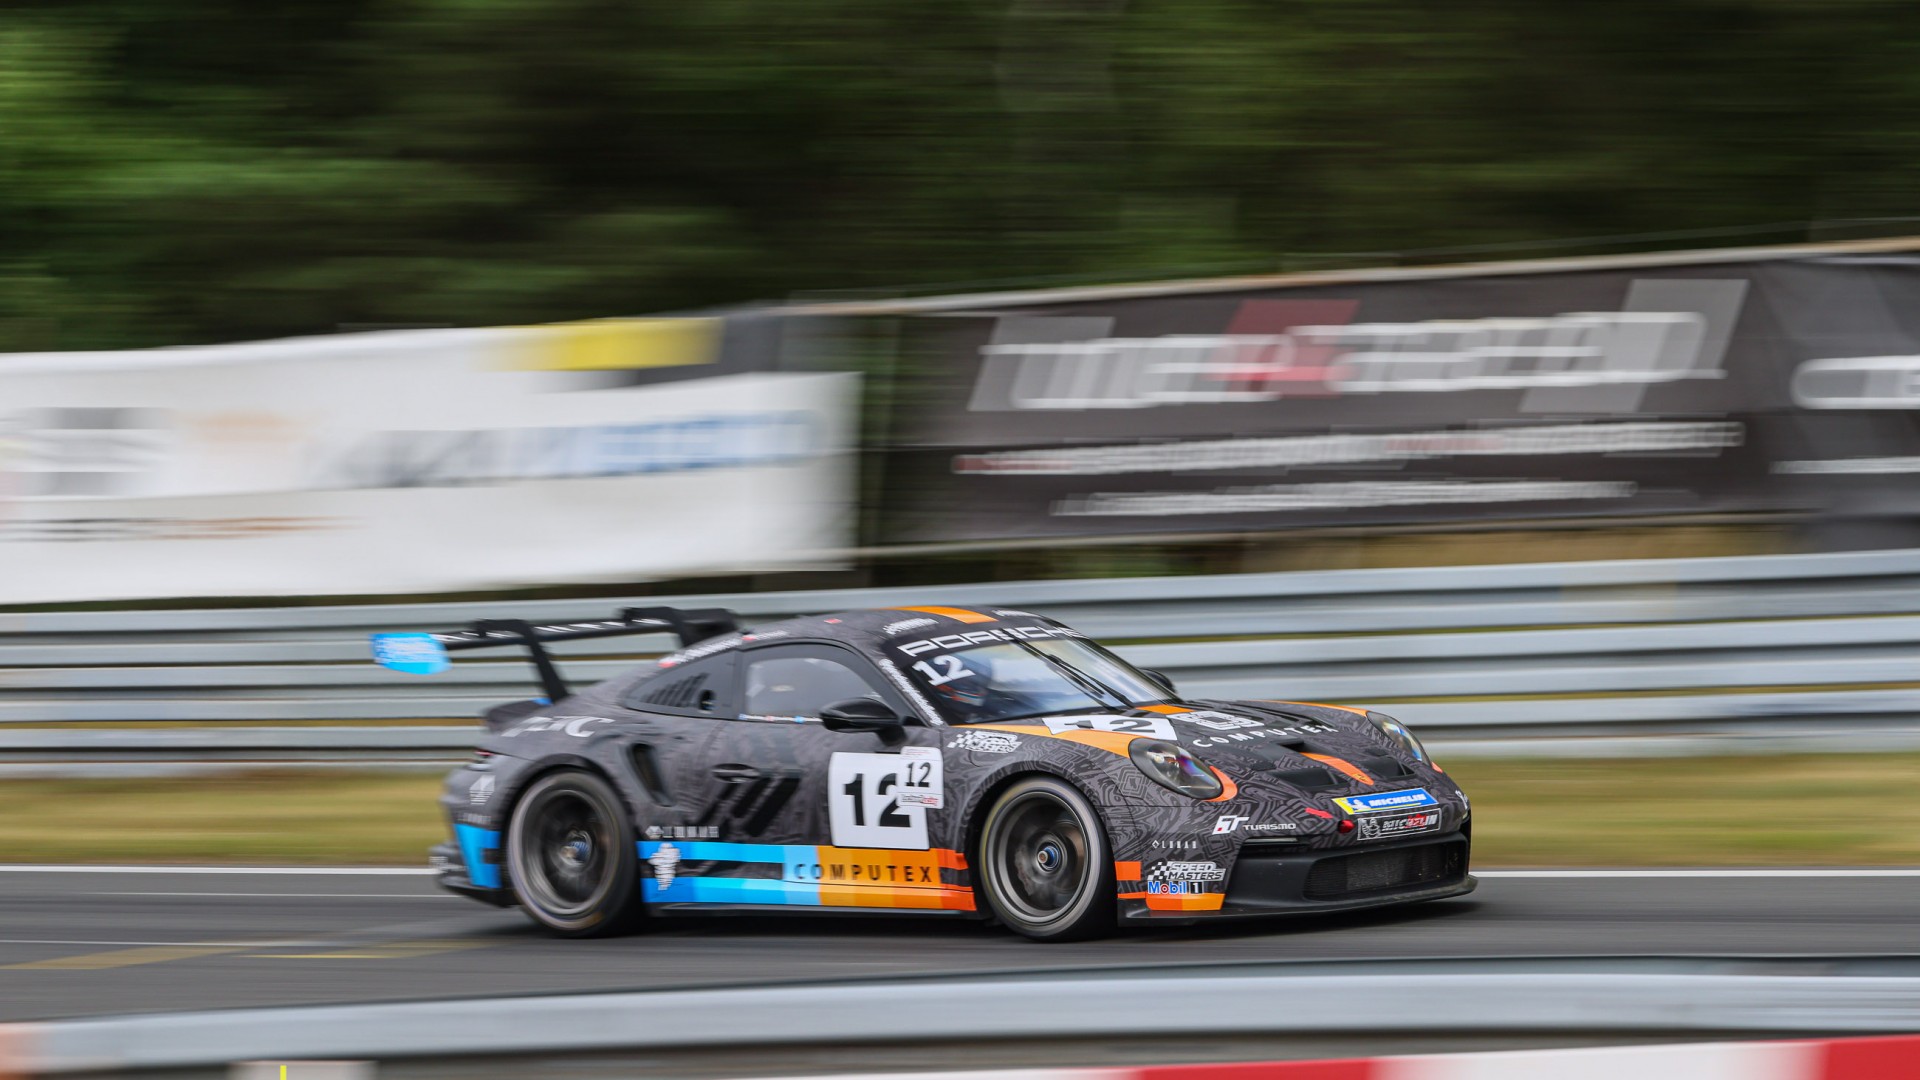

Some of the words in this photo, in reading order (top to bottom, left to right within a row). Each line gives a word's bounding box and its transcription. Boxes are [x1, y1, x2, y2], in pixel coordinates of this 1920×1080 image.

[897, 626, 1089, 657] PORSCHE
[912, 655, 976, 686] 12
[1193, 724, 1339, 747] COMPUTEX
[905, 762, 931, 787] 12
[844, 773, 911, 827] 12
[1368, 794, 1427, 807] MICHELIN
[1243, 823, 1297, 831] TURISMO
[794, 863, 932, 883] COMPUTEX
[1168, 871, 1224, 880] MASTERS
[1171, 863, 1214, 872] SPEED
[1148, 881, 1187, 894] Mobil
